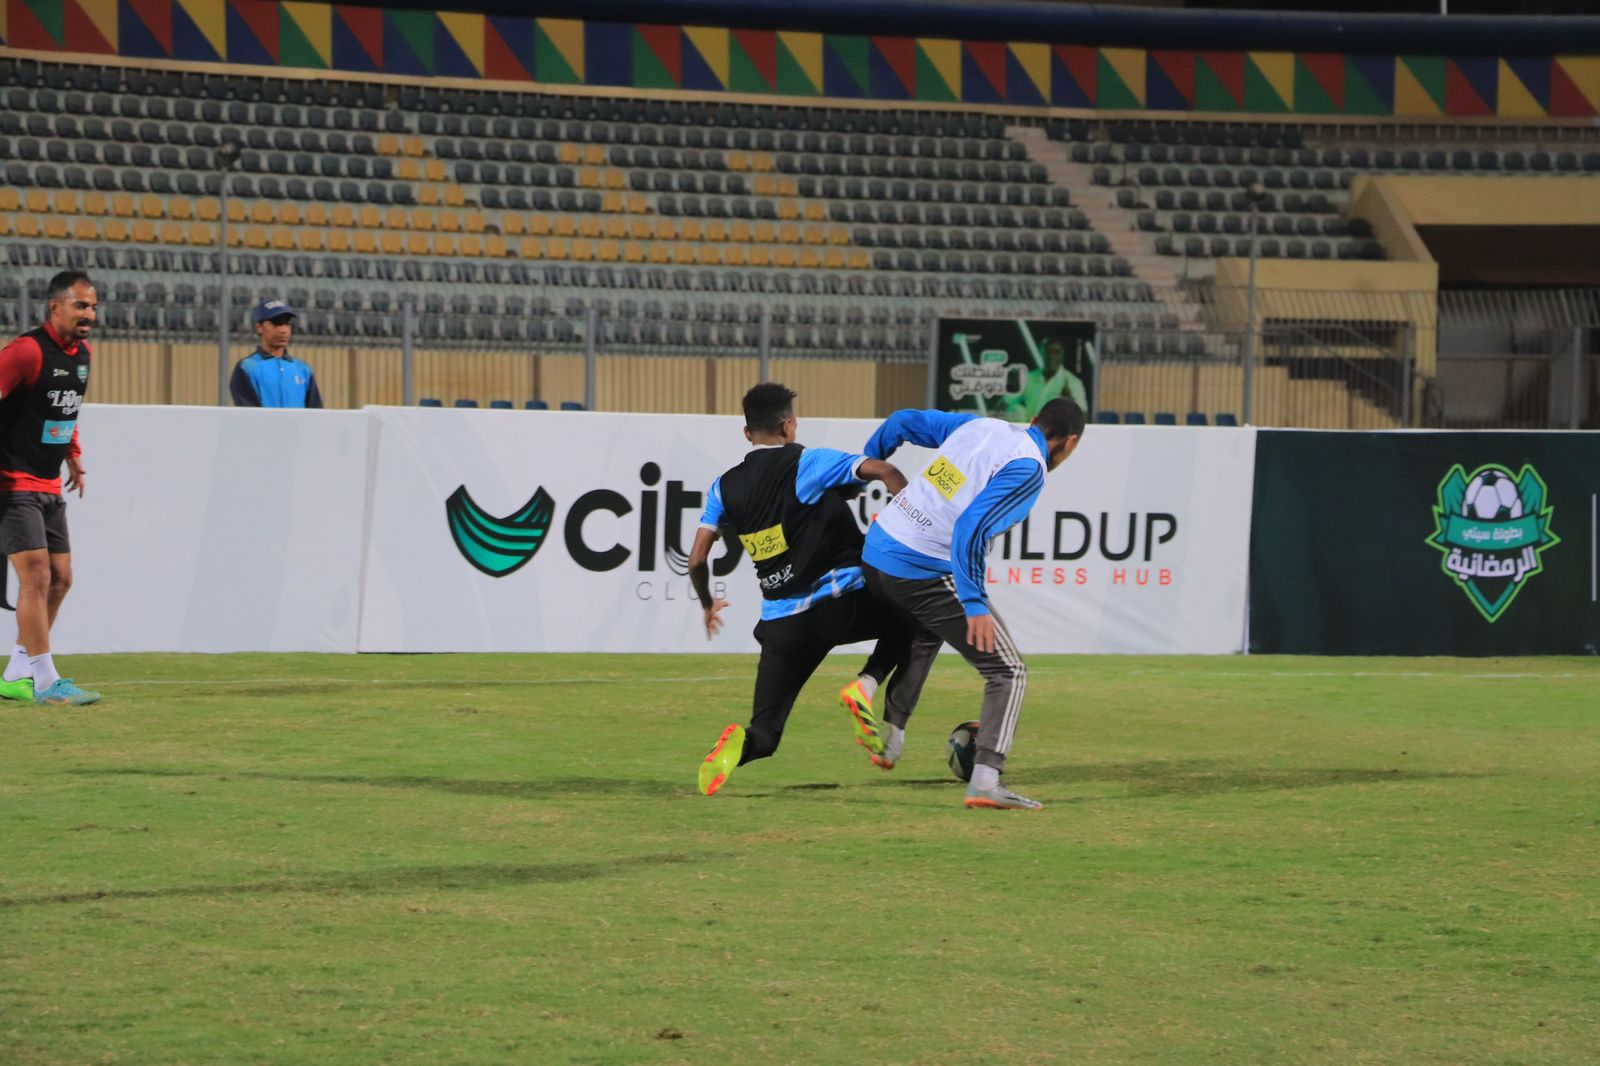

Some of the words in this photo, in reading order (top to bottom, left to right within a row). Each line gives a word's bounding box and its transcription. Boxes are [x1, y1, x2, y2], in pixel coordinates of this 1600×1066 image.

[936, 475, 953, 494] noon
[1003, 511, 1178, 562] ILDUP
[760, 541, 783, 555] noon
[1447, 546, 1538, 582] الرمضانية
[987, 566, 1088, 585] LNESS
[1113, 567, 1173, 586] HUB
